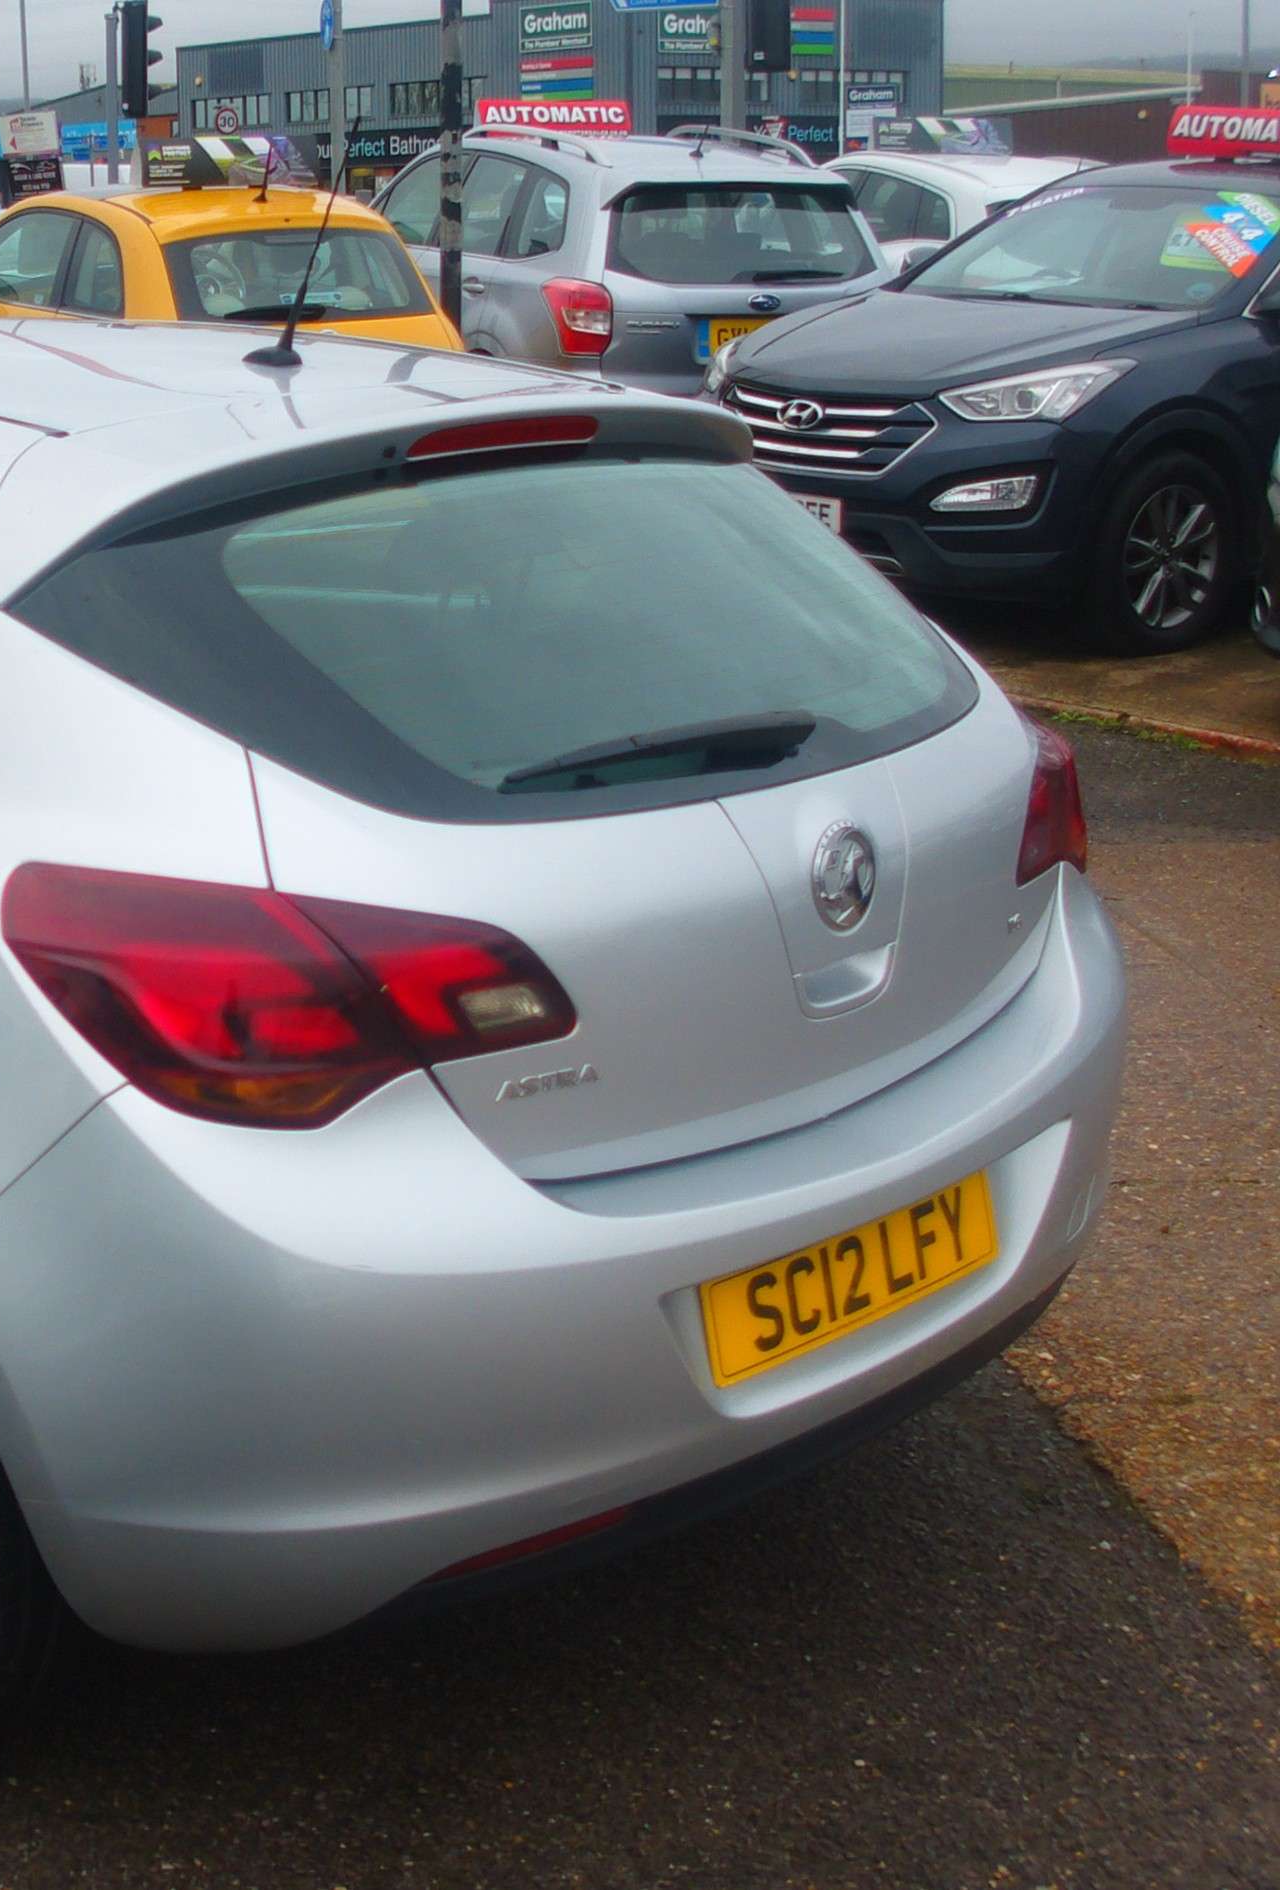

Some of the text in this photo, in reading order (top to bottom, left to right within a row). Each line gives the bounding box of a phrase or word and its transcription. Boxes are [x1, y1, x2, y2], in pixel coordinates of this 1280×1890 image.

[523, 11, 587, 34] Graham
[663, 14, 711, 34] Grah
[849, 89, 893, 101] Graham
[220, 116, 235, 128] 30
[485, 106, 625, 123] AUTOMATIC
[787, 125, 834, 142] Perfect
[1172, 114, 1278, 142] AUTOMA
[1233, 192, 1277, 226] DIESEL
[746, 1186, 963, 1352] SC12 LFY
